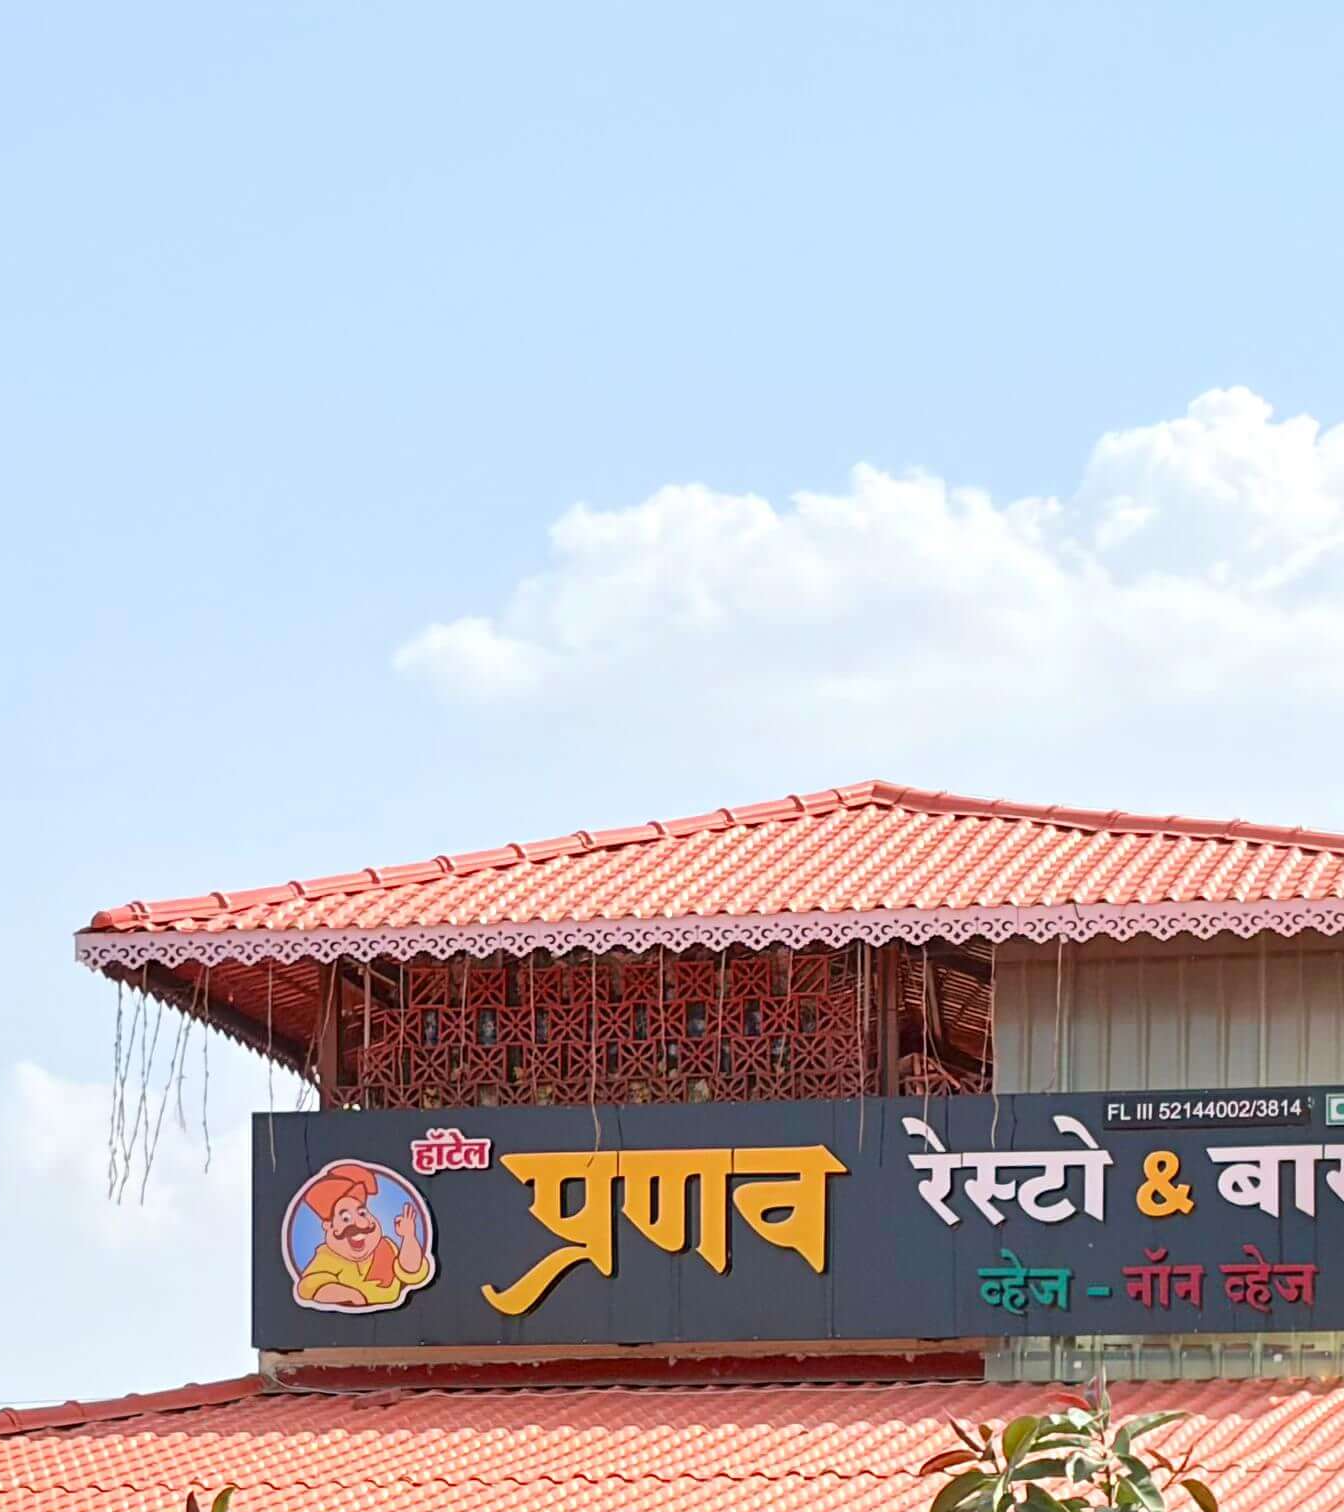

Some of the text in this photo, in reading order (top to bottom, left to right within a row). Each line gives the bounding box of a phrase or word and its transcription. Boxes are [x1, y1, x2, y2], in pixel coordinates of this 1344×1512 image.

[1107, 1098, 1302, 1121] FL III 52144002/3814
[411, 1128, 492, 1175] हॉटेल
[481, 1144, 849, 1315] प्रणव
[902, 1114, 1114, 1227] रेस्टो
[1136, 1149, 1195, 1217] &
[977, 1247, 1073, 1313] व्हेज
[1122, 1247, 1205, 1307] नॉन
[1219, 1244, 1318, 1312] व्हेज
